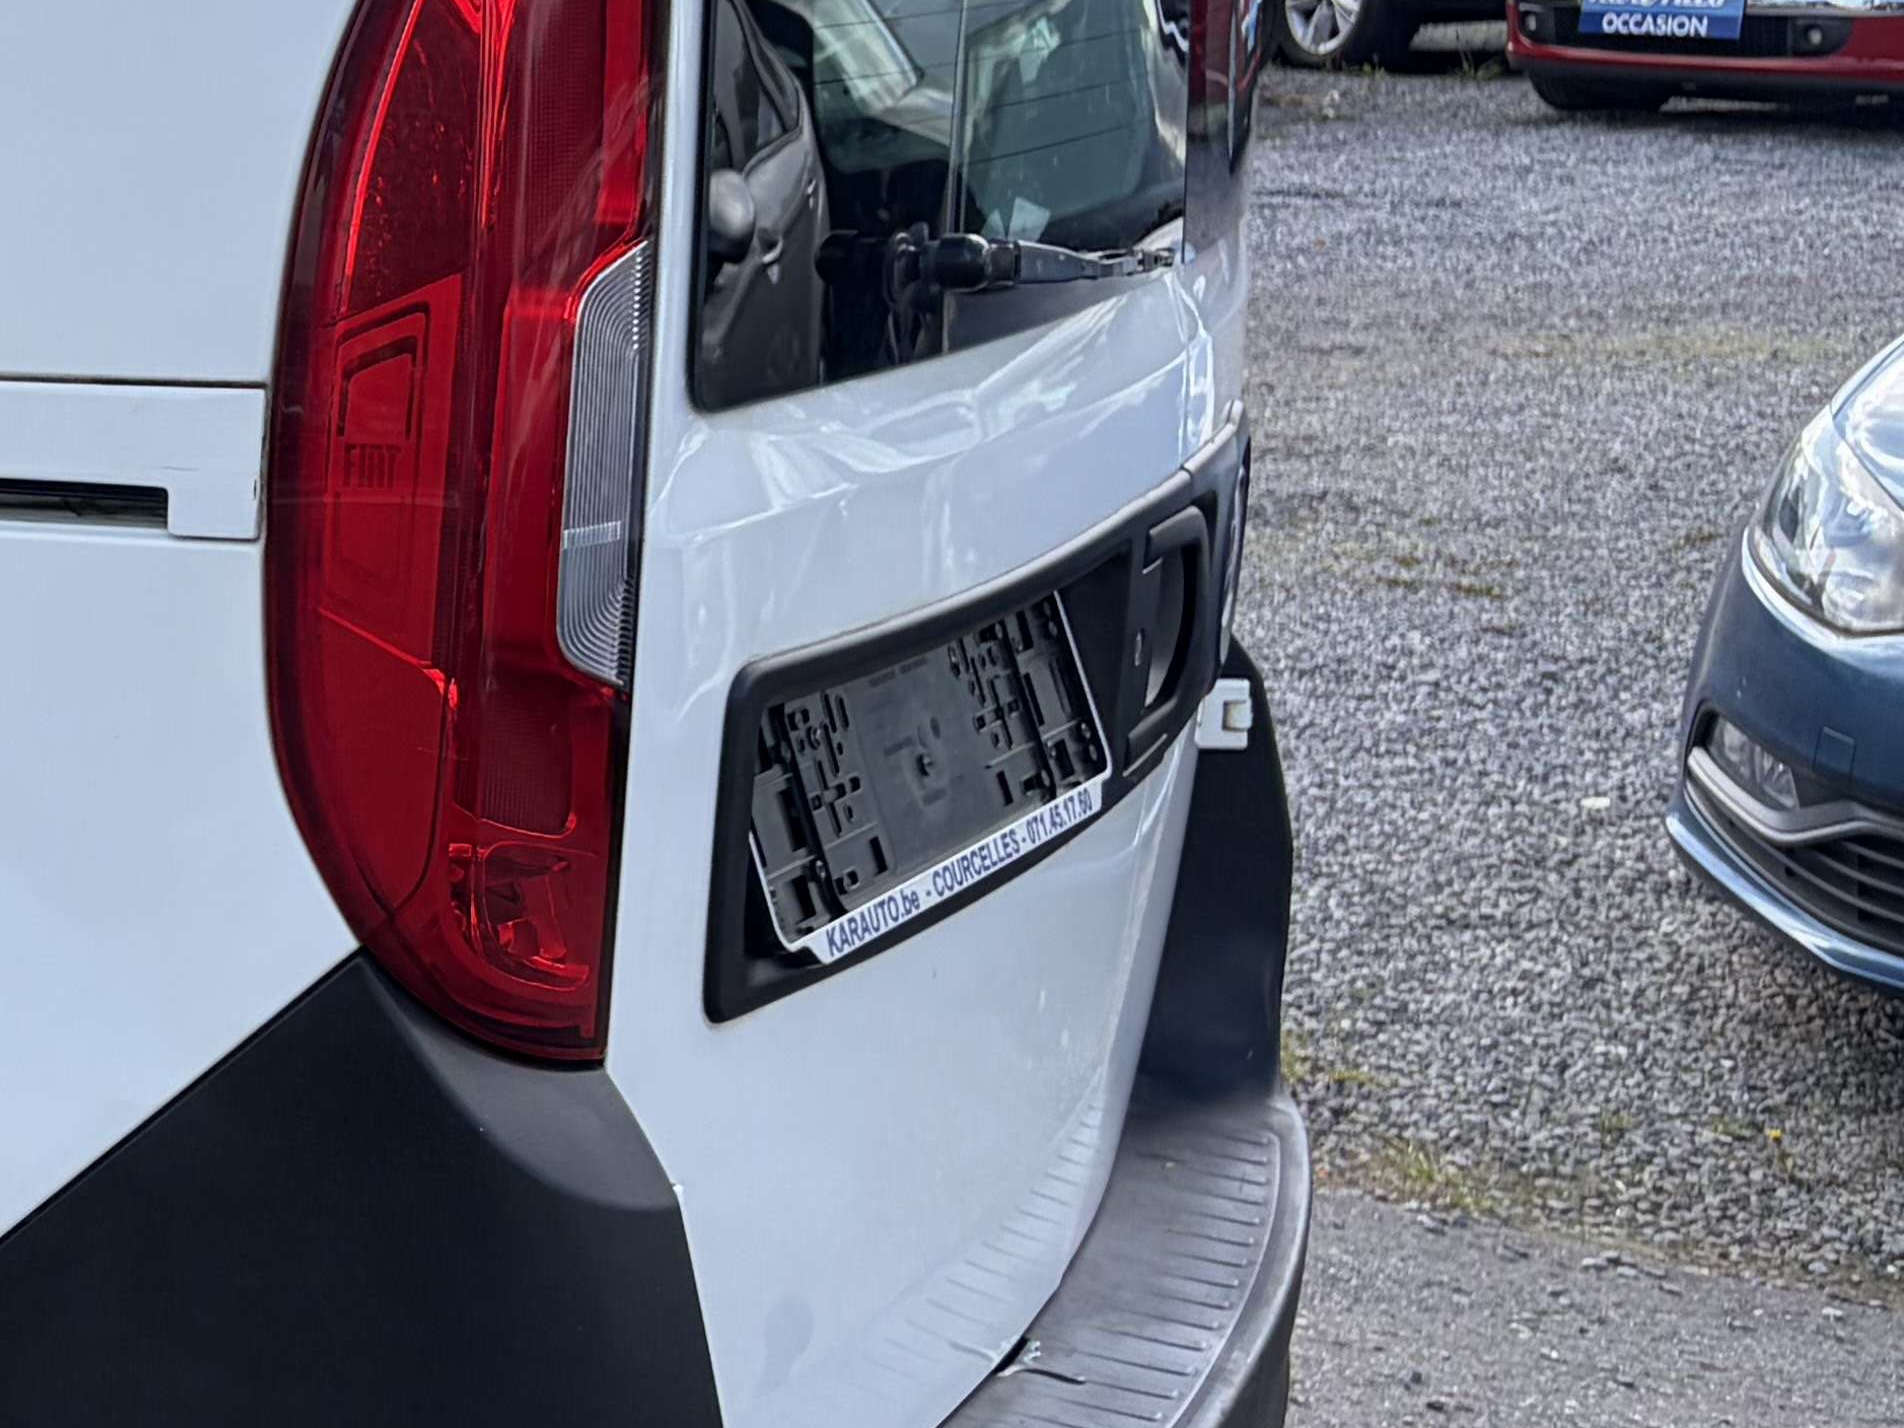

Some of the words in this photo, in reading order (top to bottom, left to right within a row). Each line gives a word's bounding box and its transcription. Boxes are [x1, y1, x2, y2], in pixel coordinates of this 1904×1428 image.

[1602, 11, 1709, 38] OCCASION
[826, 888, 921, 958] KARAUTO.be
[932, 827, 1021, 897] COURCELLES
